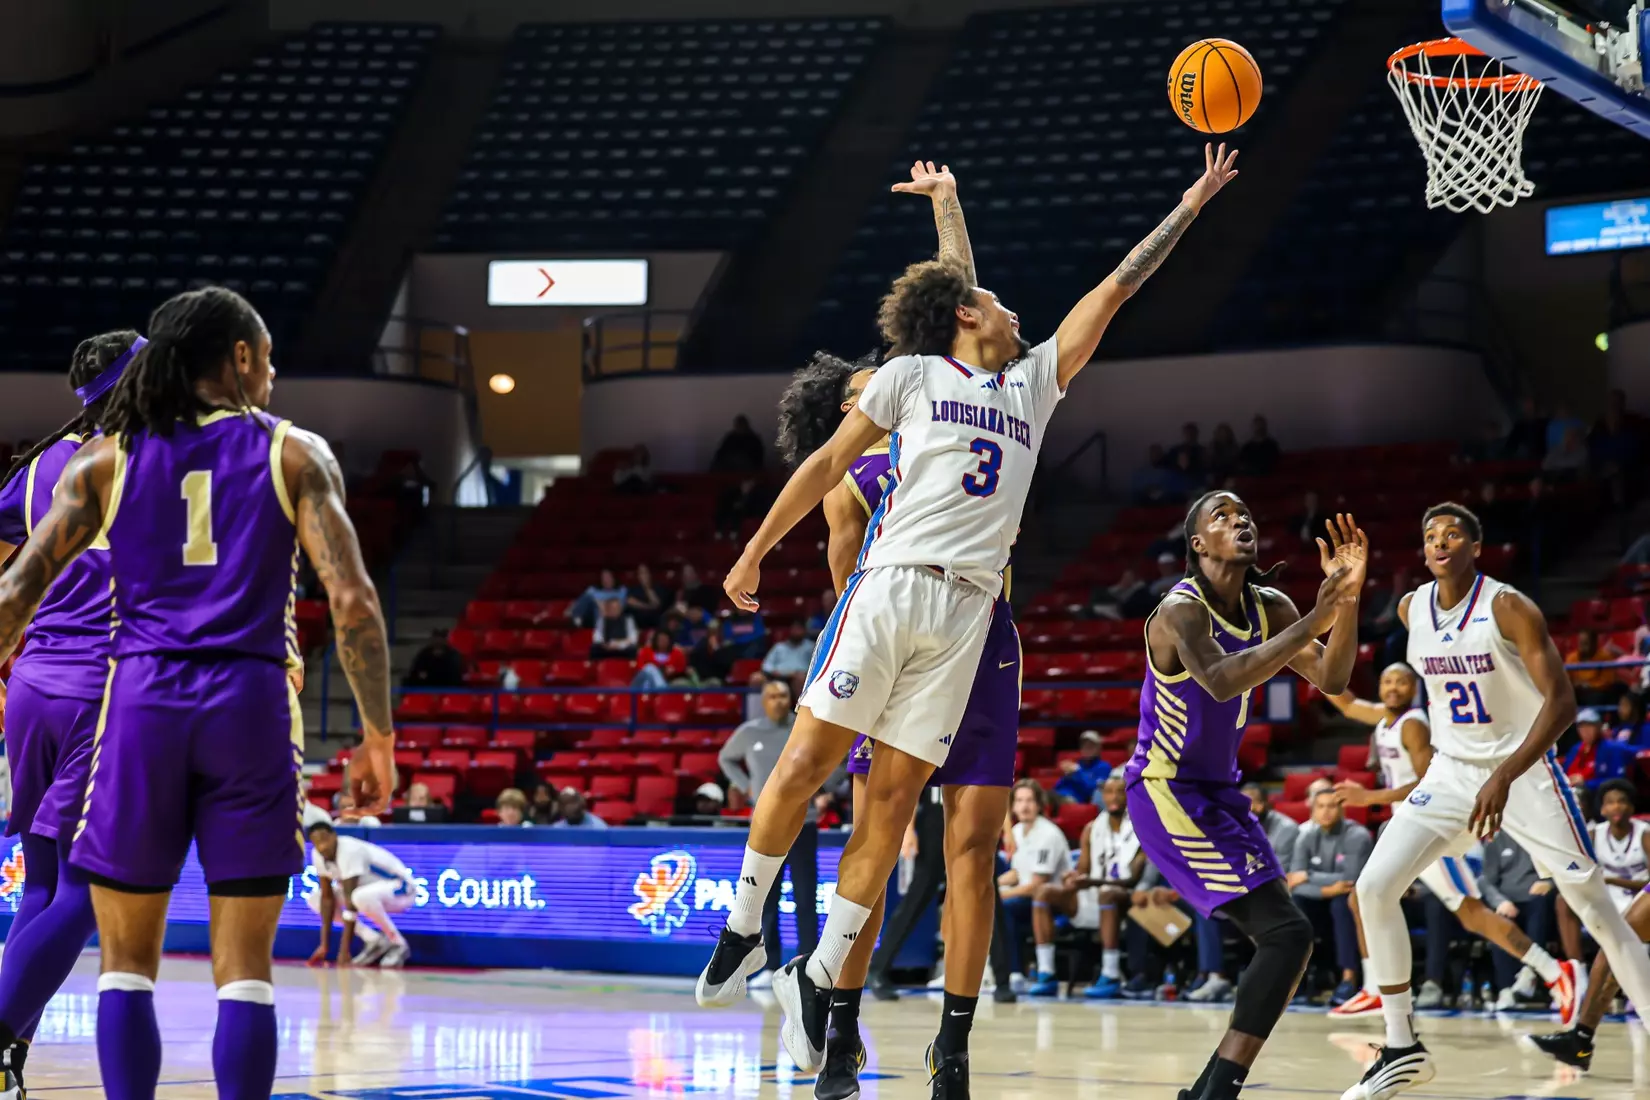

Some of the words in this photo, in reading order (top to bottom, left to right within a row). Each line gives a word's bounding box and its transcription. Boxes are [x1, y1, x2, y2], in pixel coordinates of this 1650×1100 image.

[931, 400, 1005, 436] LOUISIANA
[1007, 413, 1031, 451] TECH
[961, 437, 1003, 498] 3
[180, 469, 218, 566] 1
[1466, 652, 1495, 675] TECH
[1444, 681, 1493, 724] 21
[436, 868, 546, 909] Count.
